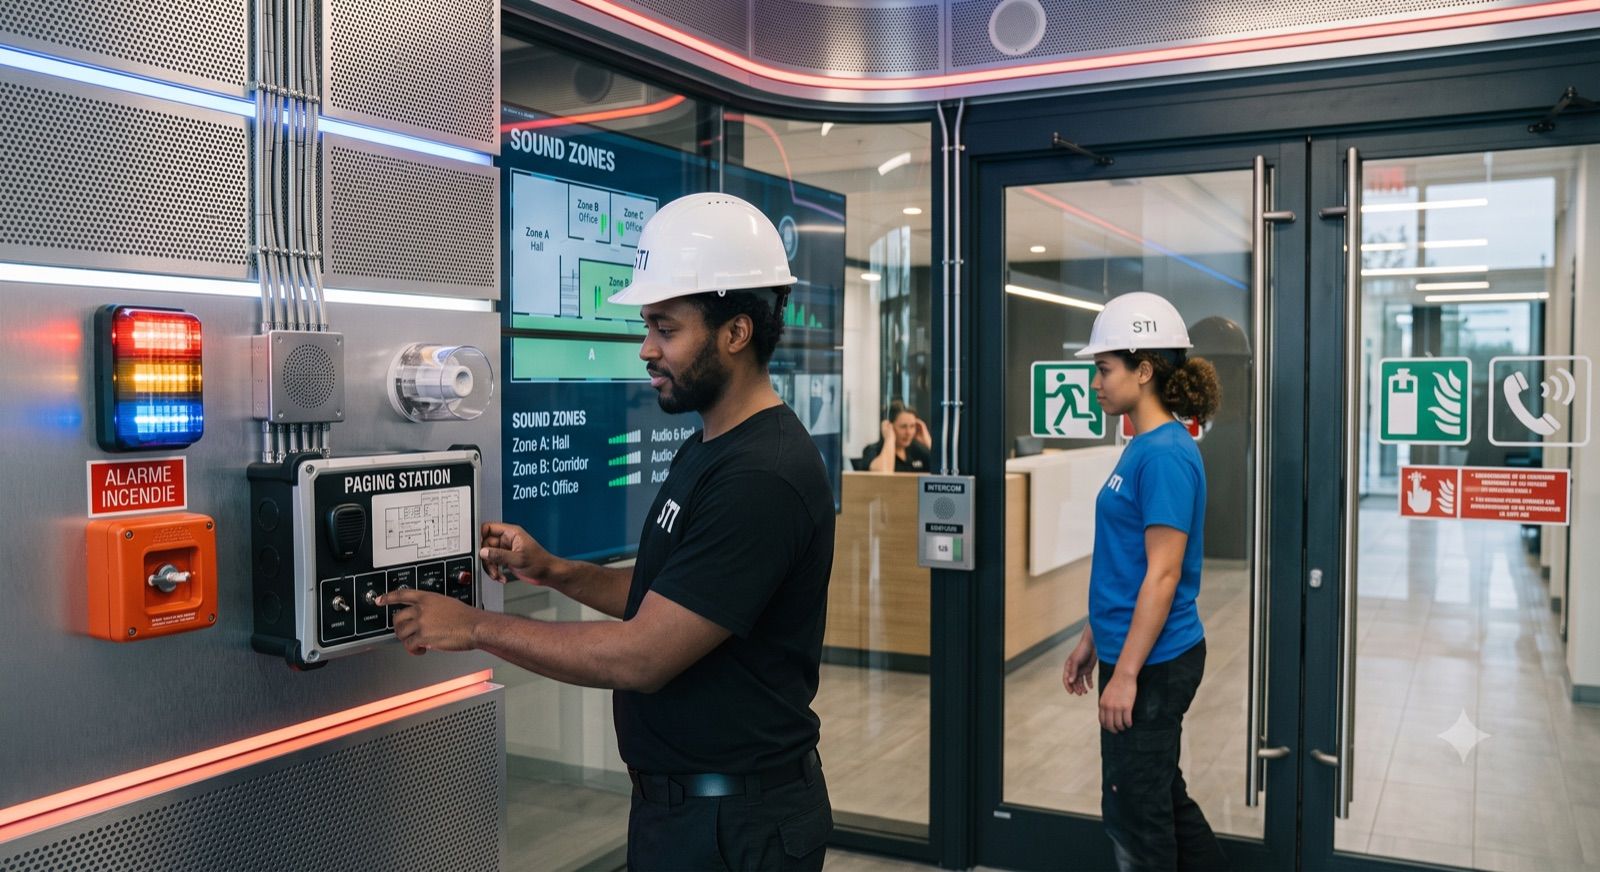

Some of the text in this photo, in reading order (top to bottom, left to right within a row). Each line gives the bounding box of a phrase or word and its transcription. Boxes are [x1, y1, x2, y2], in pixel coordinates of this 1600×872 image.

[510, 128, 616, 172] SOUND ZONES
[577, 199, 599, 212] Zone B
[578, 212, 598, 224] Office
[624, 208, 644, 220] Zone C
[526, 227, 550, 240] Zone A
[625, 221, 643, 233] Office
[530, 241, 544, 252] Hall
[609, 276, 624, 288] Zone
[1133, 320, 1157, 333] STI
[588, 347, 596, 361] A
[512, 409, 587, 428] SOUND ZONES
[651, 428, 673, 442] Audio
[512, 434, 570, 453] Zone A: Hall
[651, 448, 673, 463] Audio
[512, 456, 589, 476] Zone B: Corridor
[105, 466, 172, 487] ALARME
[344, 468, 451, 494] PAGING STATION
[651, 468, 670, 483] Audi
[512, 479, 579, 500] Zone C: Office
[927, 484, 962, 492] INTERCOM
[102, 485, 176, 508] INCENDIE
[656, 498, 681, 534] STI
